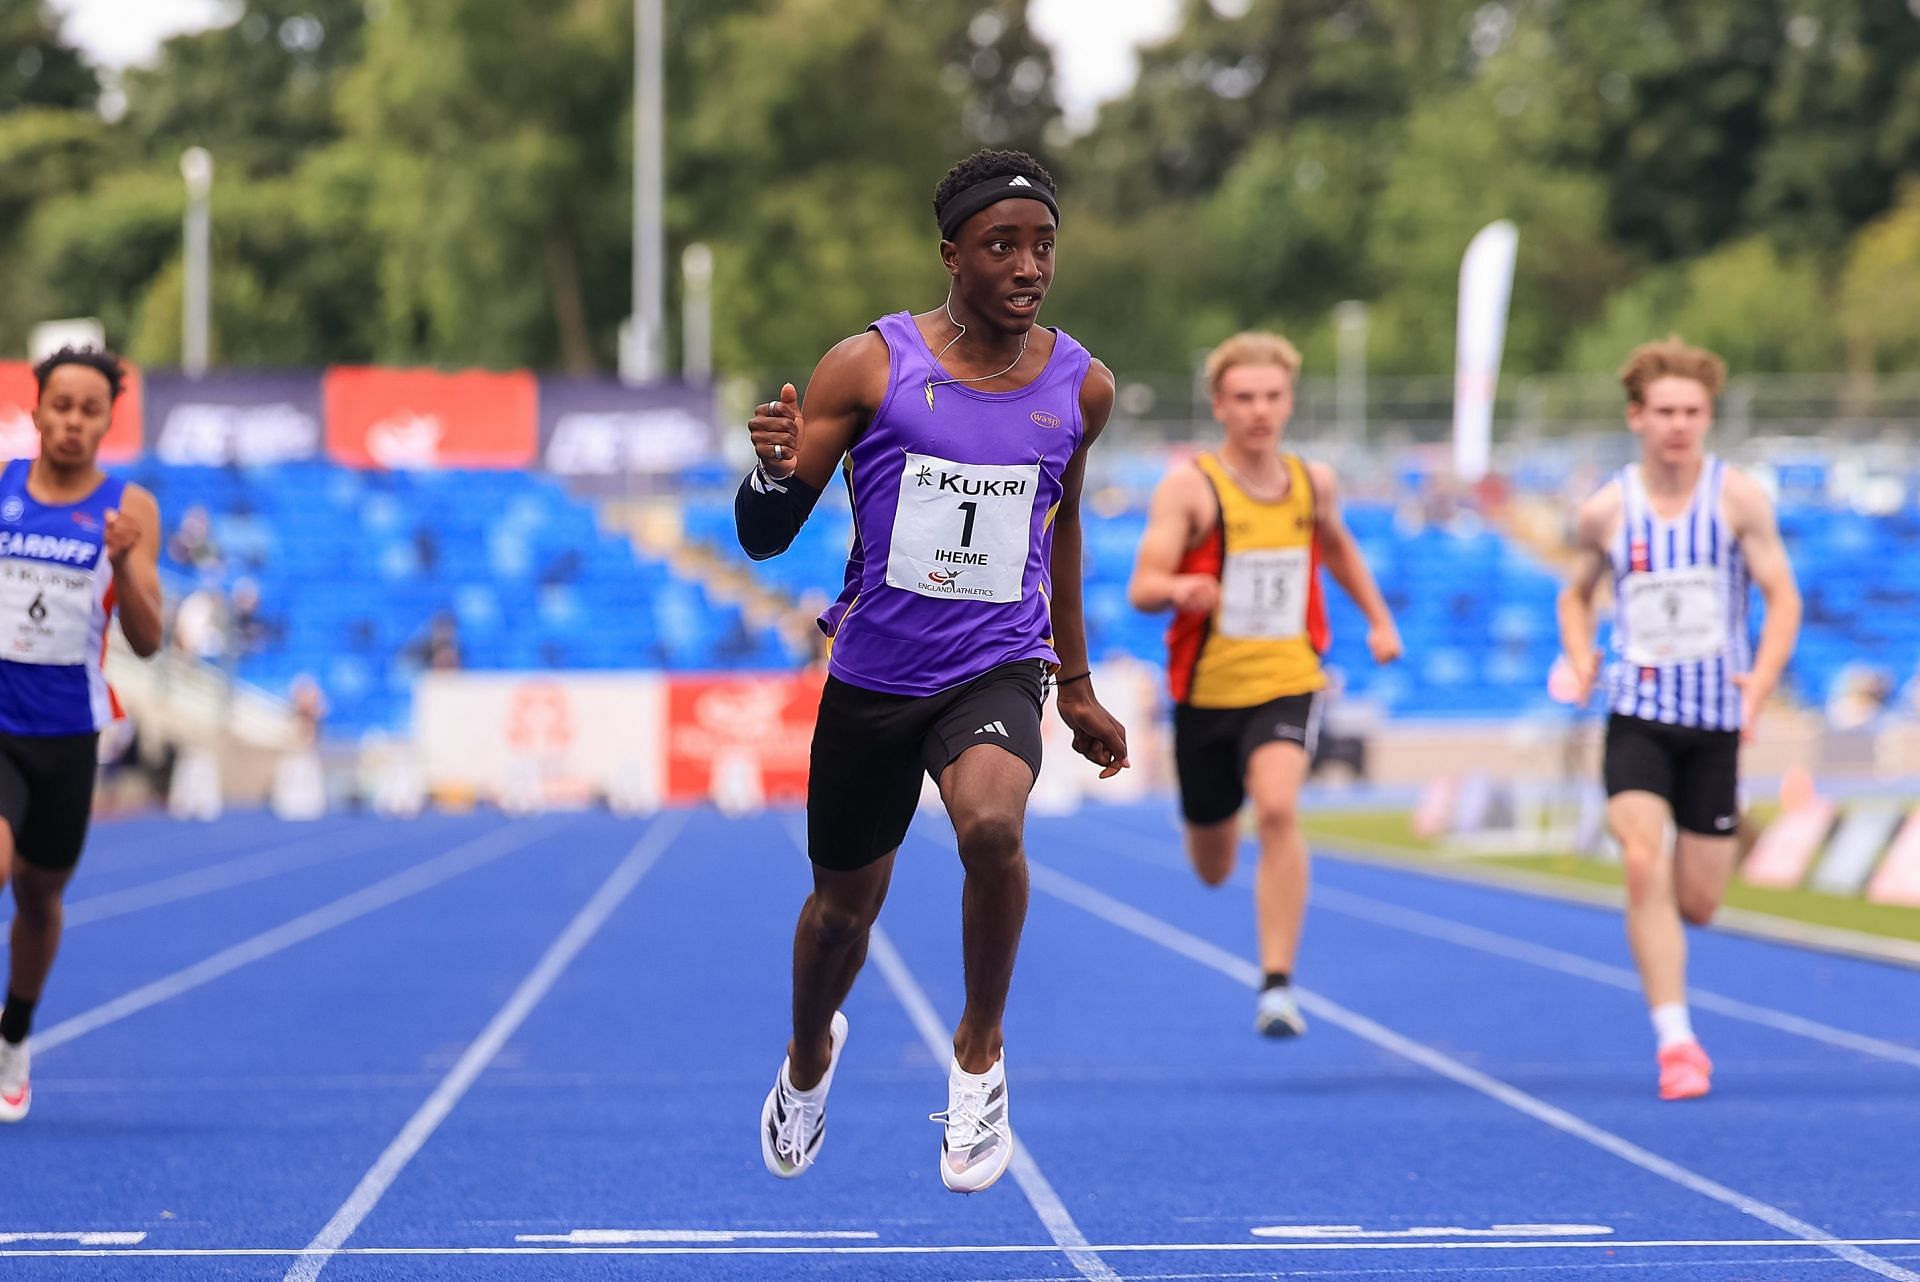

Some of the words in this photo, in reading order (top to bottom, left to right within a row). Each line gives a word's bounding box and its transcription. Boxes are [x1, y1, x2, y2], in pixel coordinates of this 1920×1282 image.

[1033, 413, 1058, 428] wasp
[938, 472, 1026, 497] KUKRI
[957, 501, 978, 548] 1
[0, 531, 96, 564] CARDIFF
[935, 549, 989, 566] IHEME
[918, 581, 953, 593] ENGLAND
[954, 586, 994, 597] ATHLETICS
[28, 591, 47, 623] 6
